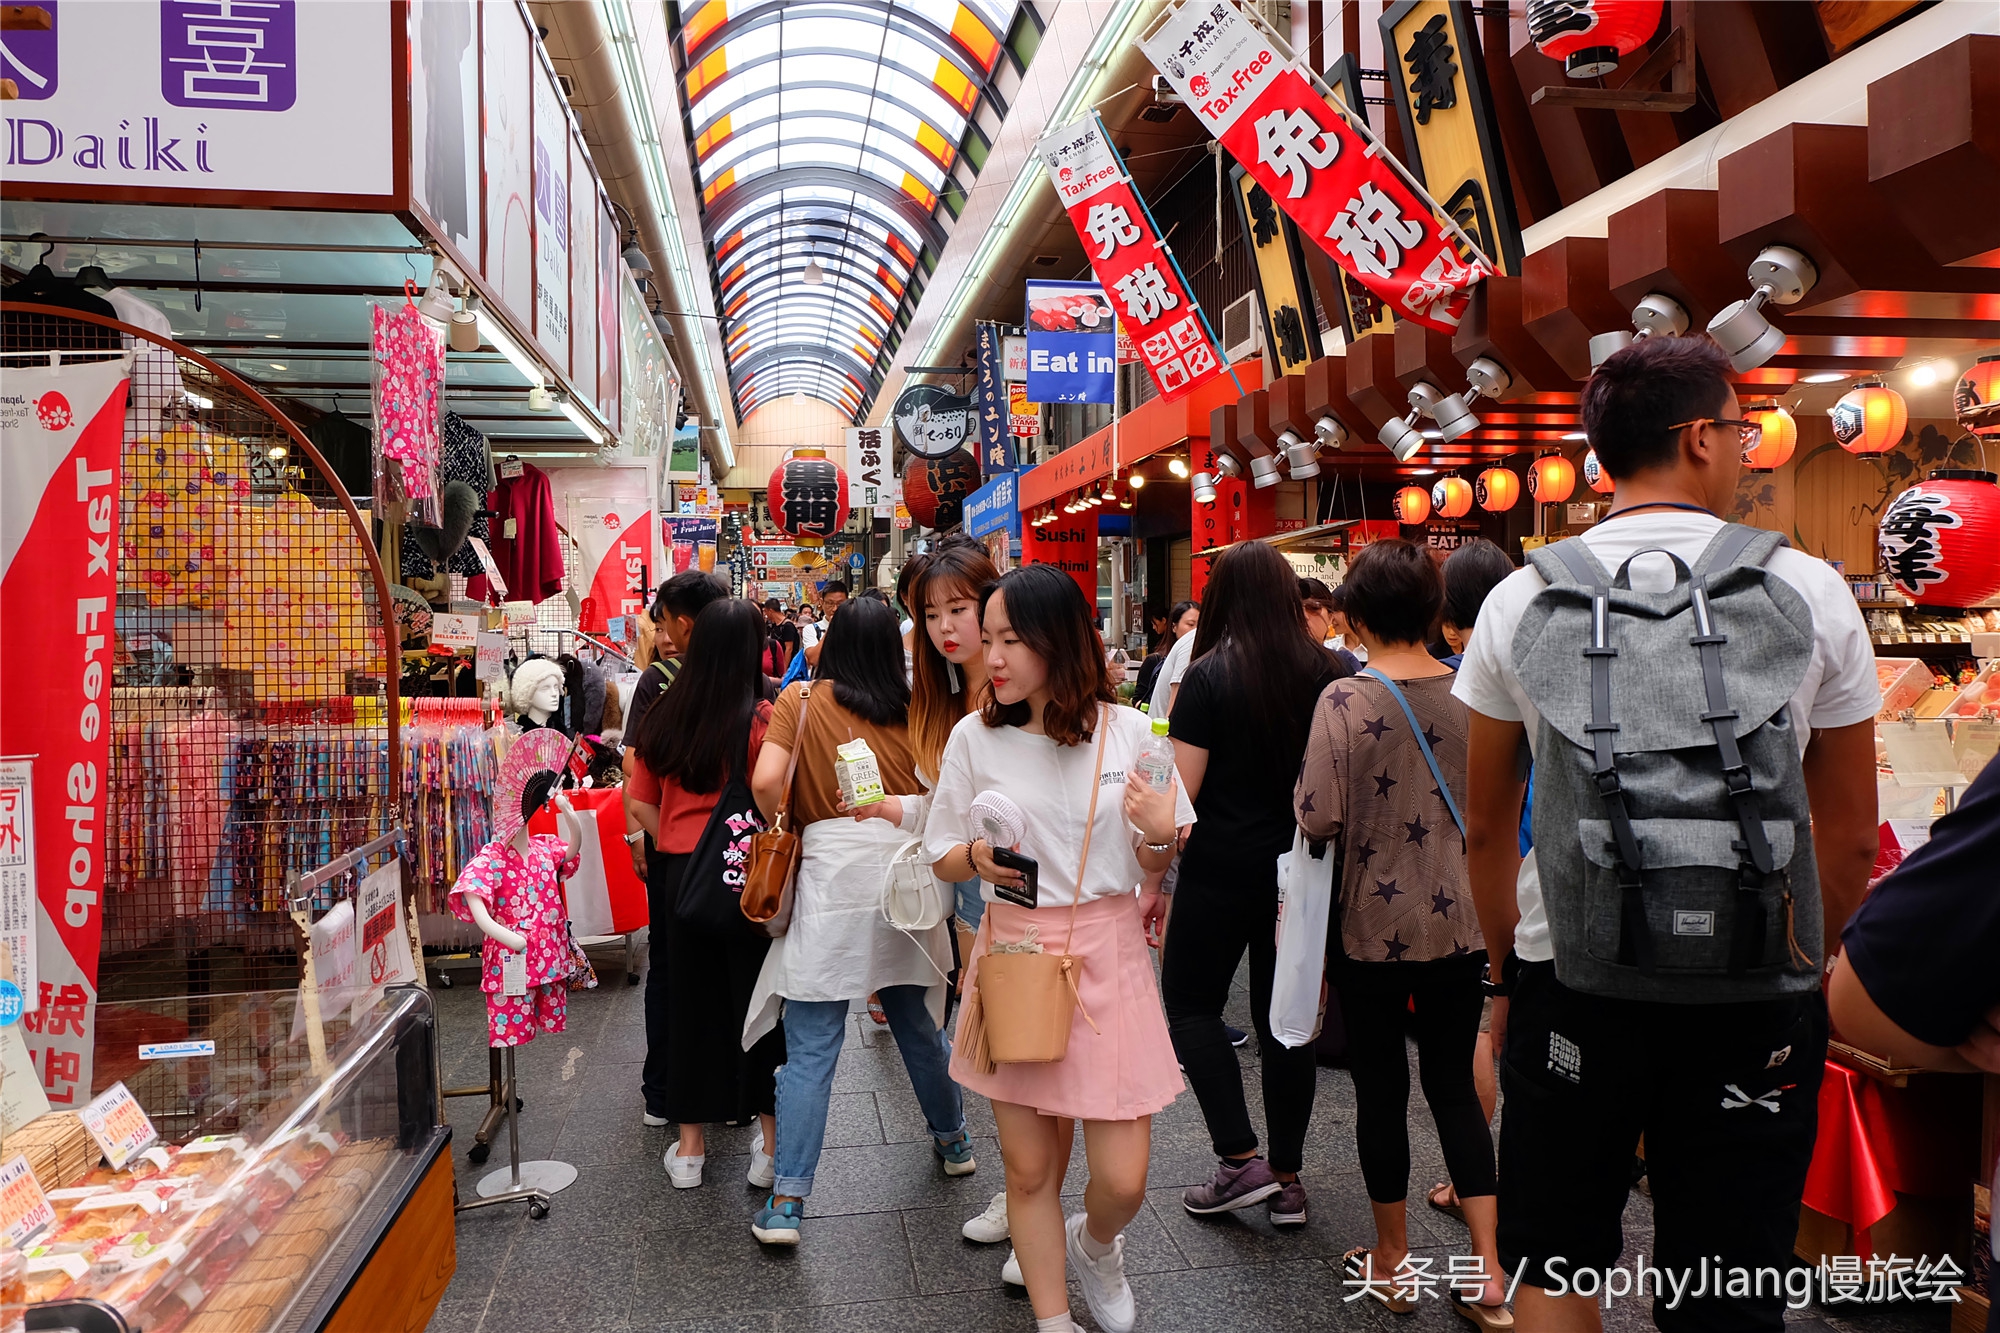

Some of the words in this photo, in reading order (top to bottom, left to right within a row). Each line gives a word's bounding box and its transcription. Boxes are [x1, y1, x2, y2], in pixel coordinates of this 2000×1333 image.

[1179, 4, 1229, 58] 千成屋
[1189, 17, 1236, 66] SENNARIYA
[1200, 50, 1272, 121] Tax-Free
[5, 117, 215, 173] Daiki
[1058, 131, 1097, 156] 千成屋
[1061, 165, 1115, 198] Tax-Free
[1254, 107, 1423, 279] 免税
[1084, 203, 1178, 326] 免税
[1031, 350, 1078, 373] Eat
[1087, 352, 1114, 374] in
[926, 426, 962, 442] てっちり
[858, 430, 882, 486] 活ふぐ
[782, 461, 838, 535] 黒門
[1035, 528, 1086, 542] Sushi
[1428, 536, 1458, 549] EAT
[1290, 560, 1325, 577] imple
[851, 769, 878, 781] GREEN
[131, 1124, 152, 1145] 350円
[21, 1204, 49, 1231] 500円
